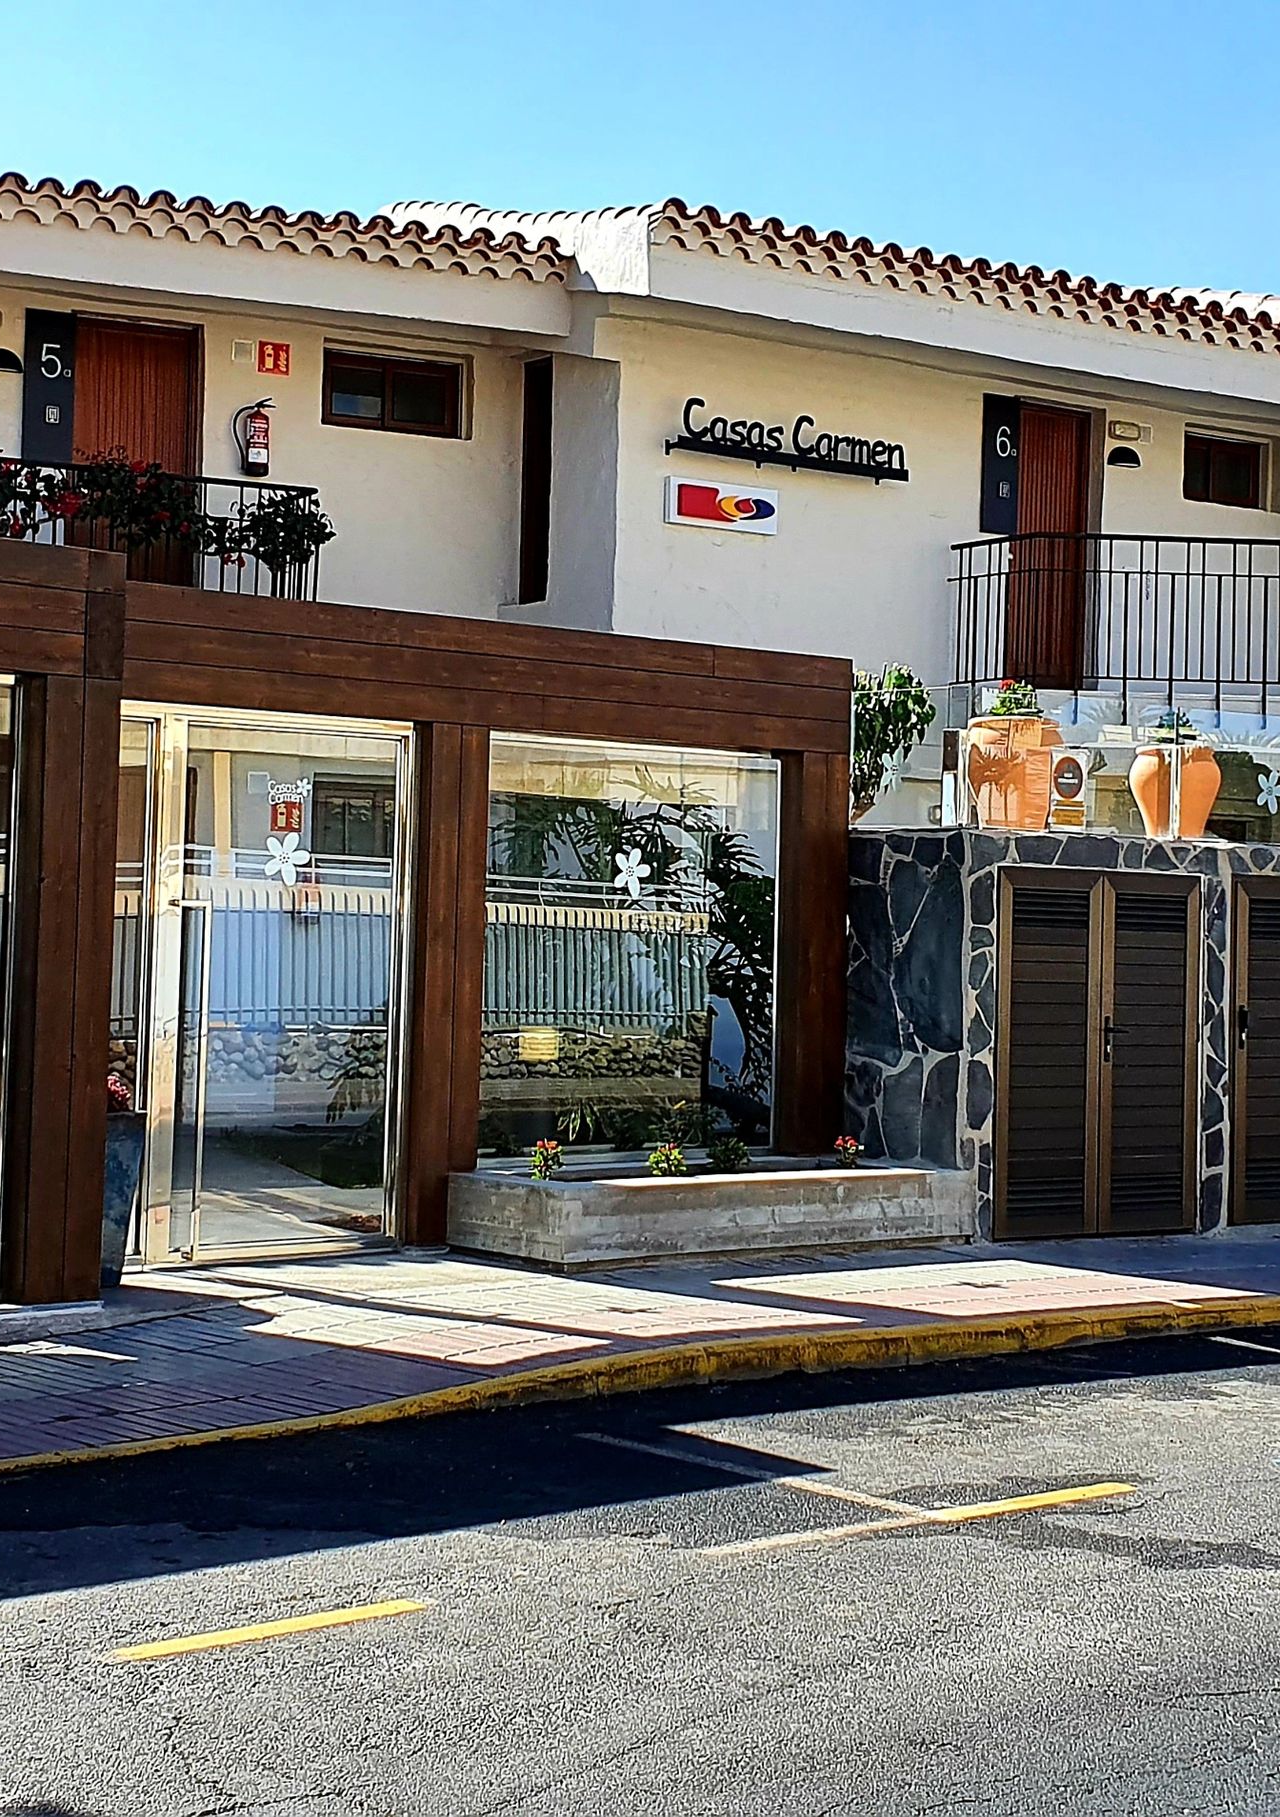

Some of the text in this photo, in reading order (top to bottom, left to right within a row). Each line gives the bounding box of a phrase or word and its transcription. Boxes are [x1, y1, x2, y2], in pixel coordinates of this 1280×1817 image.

[683, 397, 906, 471] Casas Carmen
[268, 780, 296, 794] Casas
